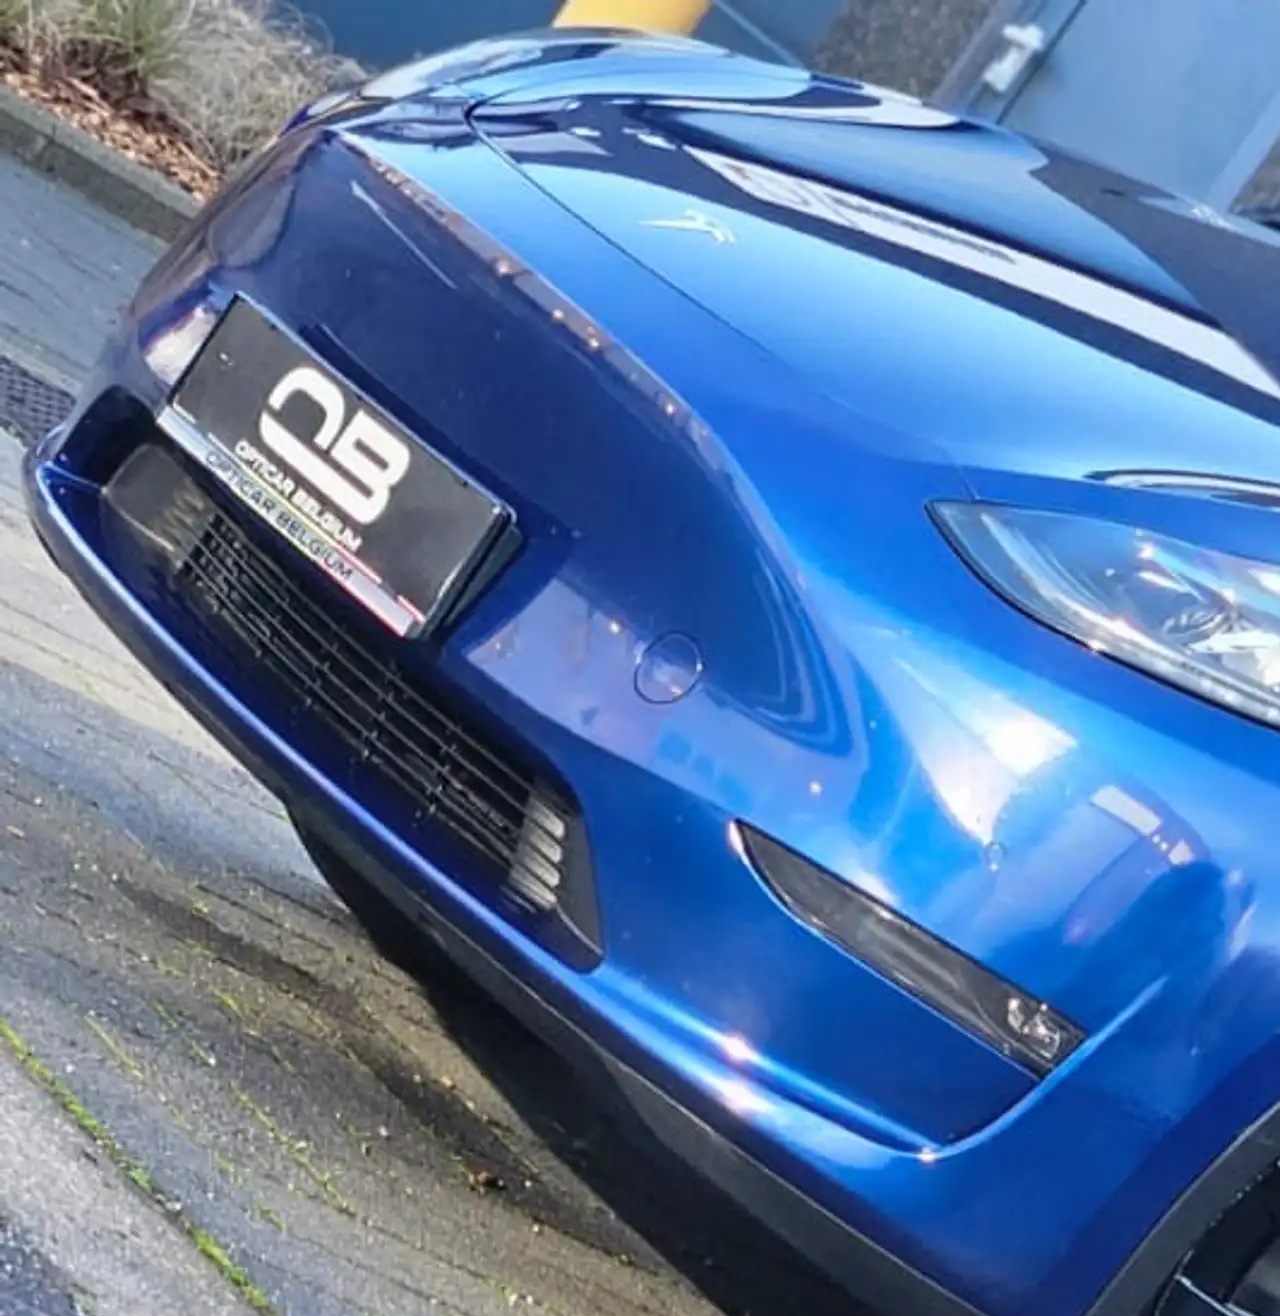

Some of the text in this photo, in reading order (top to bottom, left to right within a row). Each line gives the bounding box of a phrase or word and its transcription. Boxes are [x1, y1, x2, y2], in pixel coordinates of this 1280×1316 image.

[205, 450, 354, 580] OPTICAR BELGIUM
[234, 439, 364, 552] OPTICAR BELGIUM
